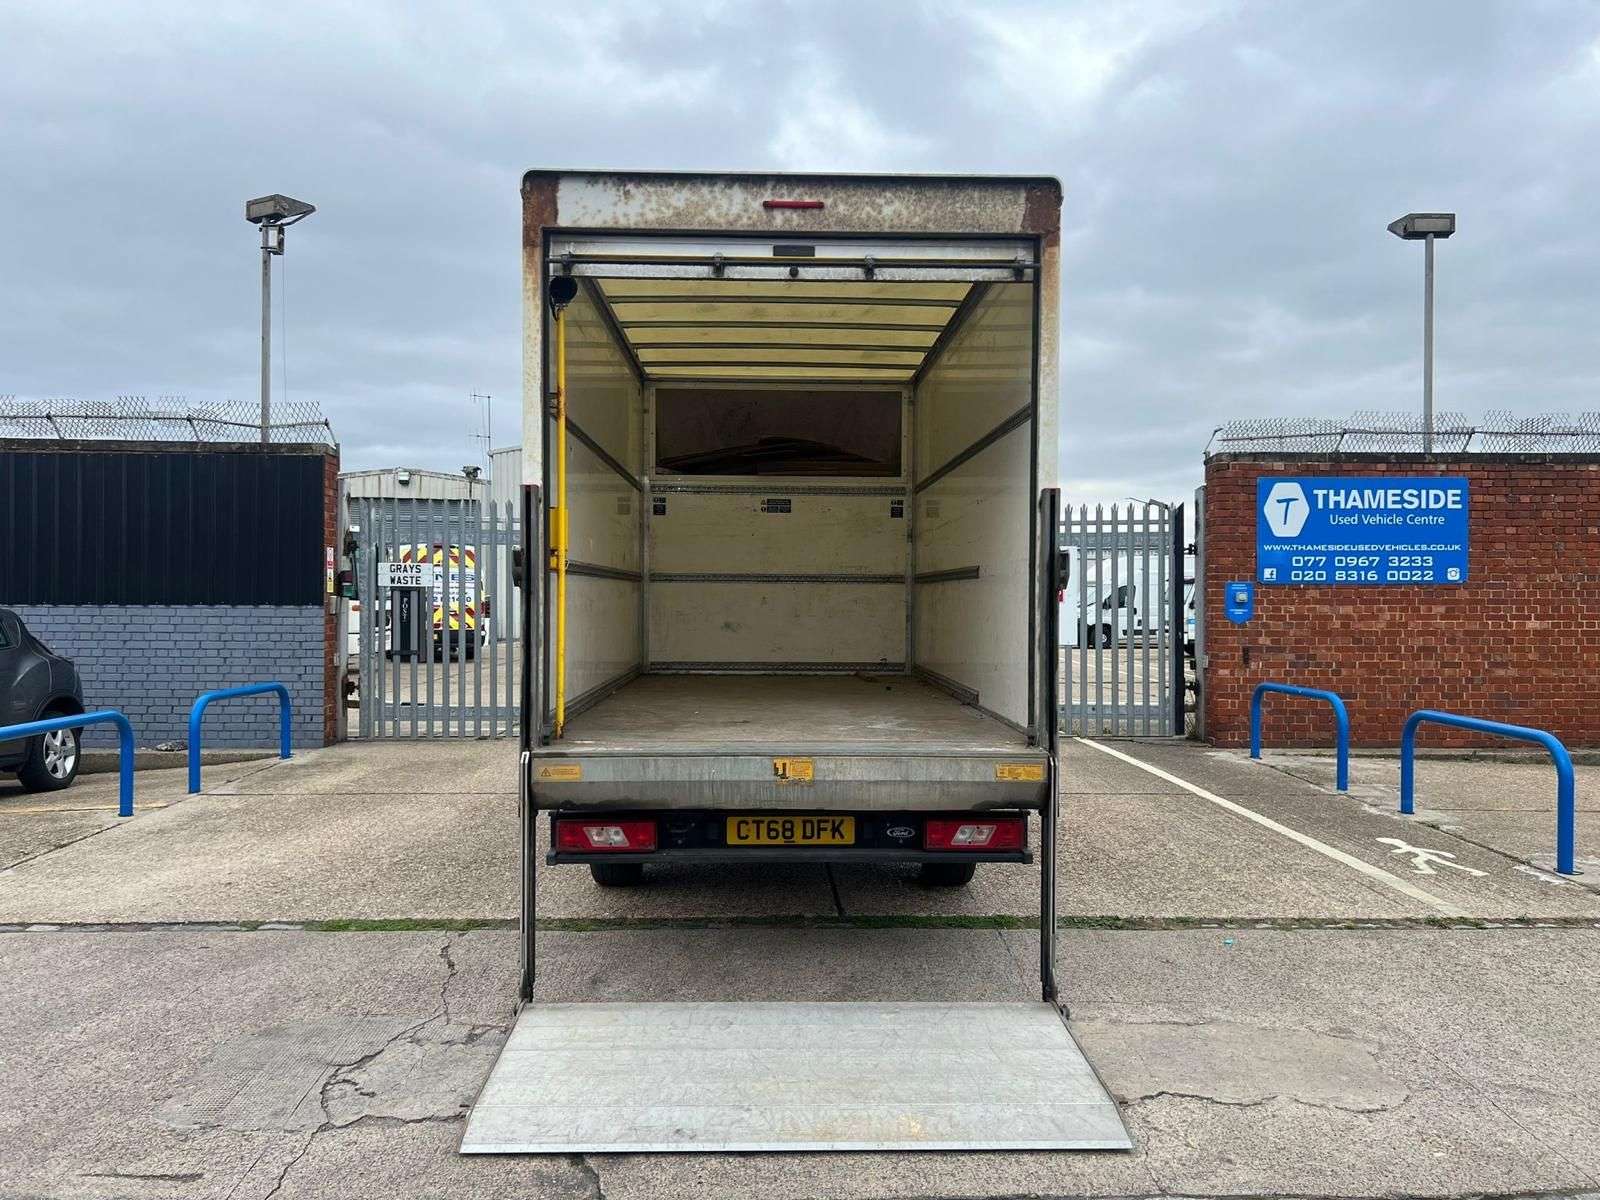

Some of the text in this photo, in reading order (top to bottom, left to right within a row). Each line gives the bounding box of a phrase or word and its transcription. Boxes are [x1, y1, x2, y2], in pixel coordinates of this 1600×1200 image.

[1313, 489, 1462, 509] THAMESIDE
[1329, 514, 1445, 525] Used Vehicle Centre
[1292, 556, 1433, 567] 077 0967 3233
[389, 563, 422, 574] GRAYS
[389, 575, 422, 585] WASTE
[1291, 570, 1434, 581] 020 8316 0022
[736, 819, 845, 840] CT68 DFK
